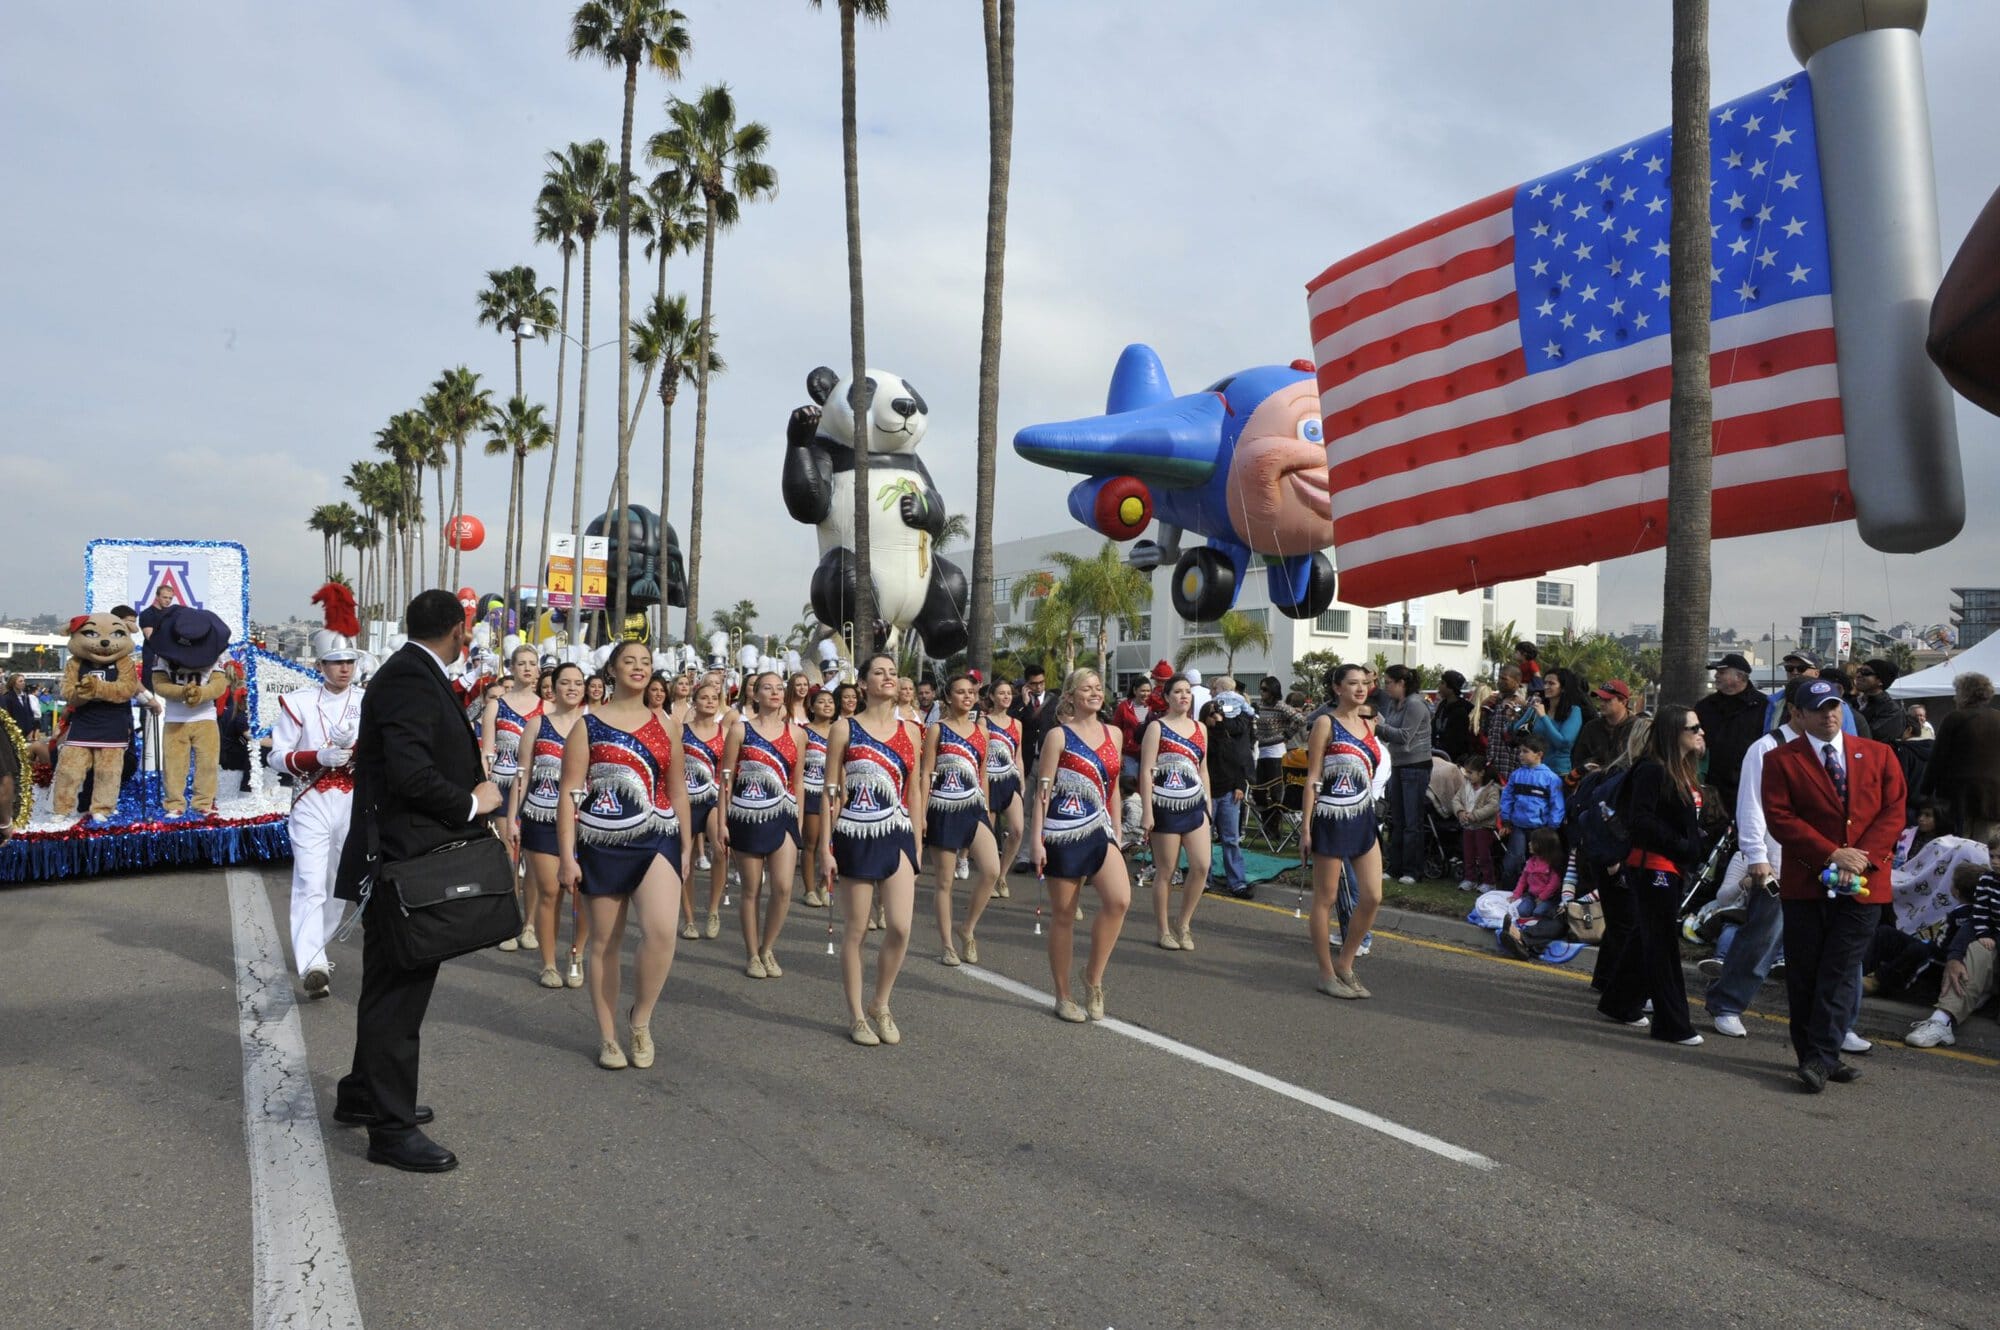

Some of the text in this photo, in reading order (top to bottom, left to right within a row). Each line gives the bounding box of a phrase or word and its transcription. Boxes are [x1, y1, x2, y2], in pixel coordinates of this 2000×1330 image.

[135, 560, 203, 615] A
[345, 705, 360, 719] A
[496, 748, 518, 768] A
[987, 752, 1002, 768] A
[684, 768, 699, 788] A
[806, 764, 825, 780] A
[941, 768, 965, 793] A
[1164, 768, 1187, 790] A
[534, 776, 559, 798] A
[742, 778, 767, 801] A
[1331, 771, 1357, 796] A
[591, 788, 623, 816] A
[849, 783, 881, 813] A
[1058, 792, 1087, 818] A
